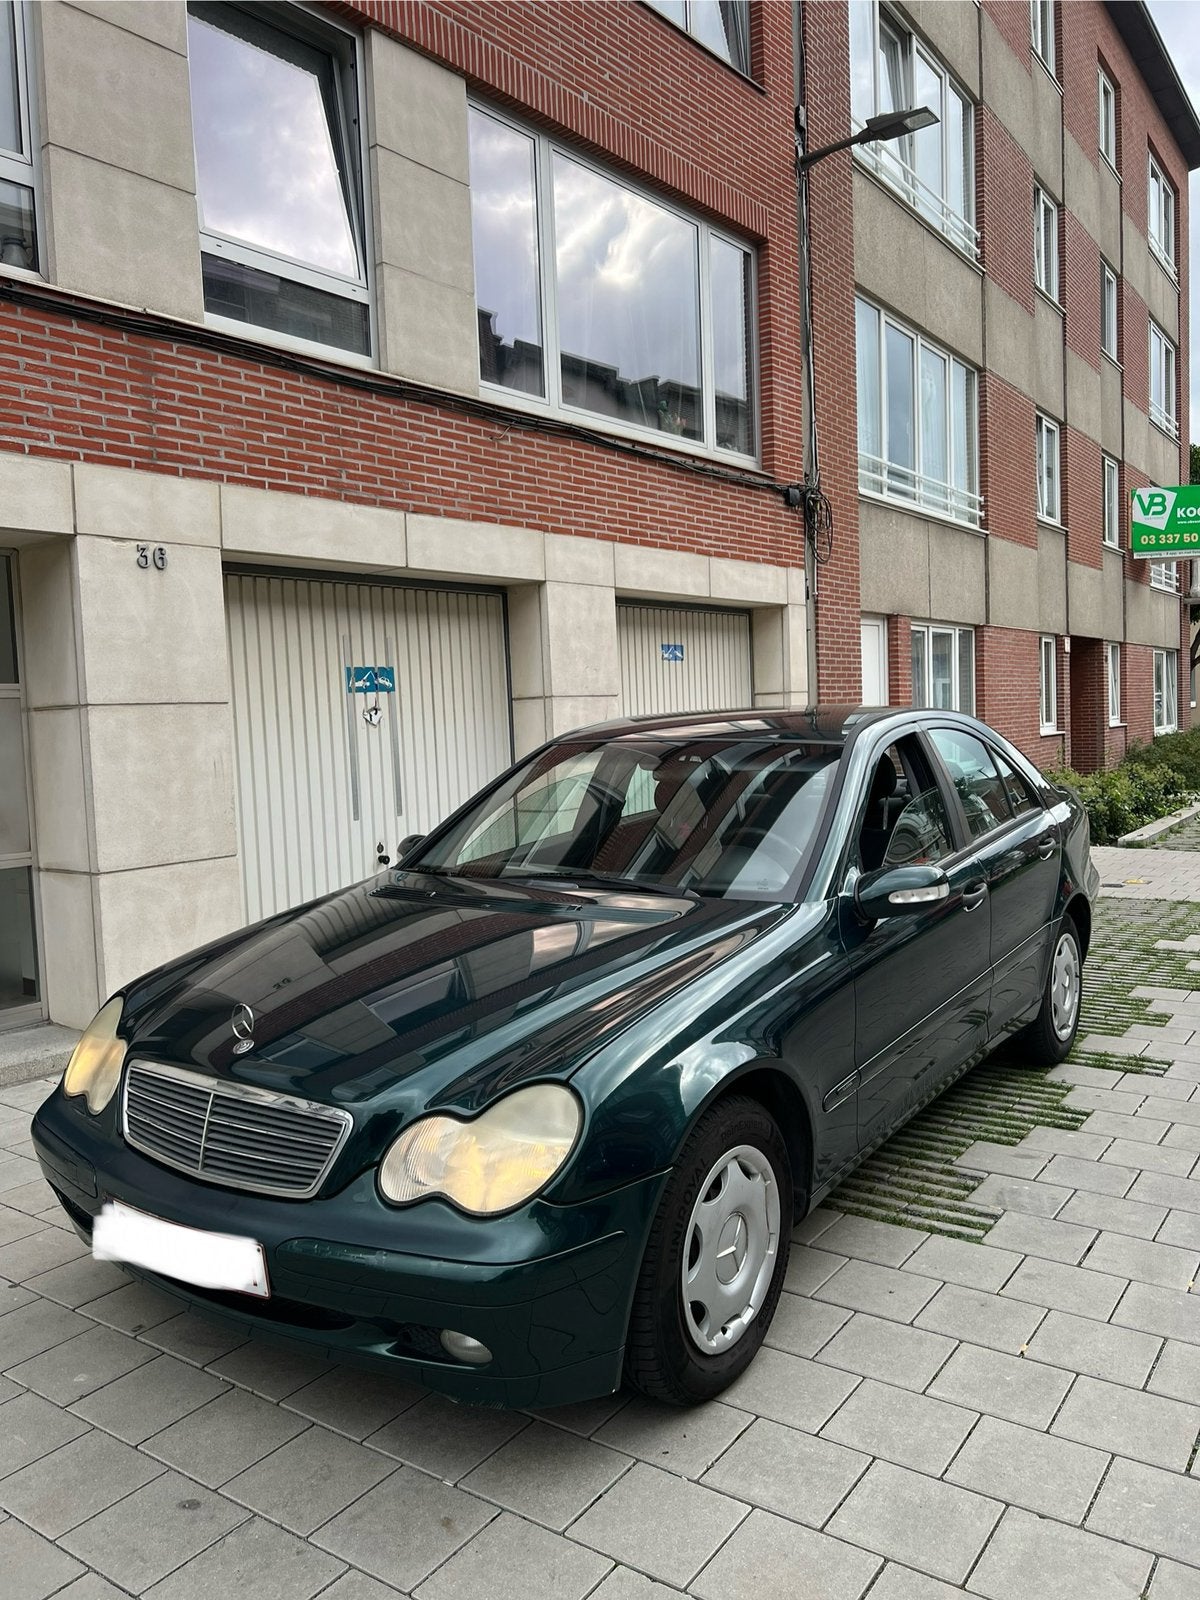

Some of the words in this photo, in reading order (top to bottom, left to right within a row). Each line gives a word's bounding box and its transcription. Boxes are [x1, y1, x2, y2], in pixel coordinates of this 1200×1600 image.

[1136, 493, 1167, 516] VB
[1140, 535, 1156, 545] 03
[1159, 534, 1180, 544] 337
[1183, 533, 1199, 543] 50
[136, 543, 168, 571] 36
[670, 1157, 711, 1264] UNIROYAL
